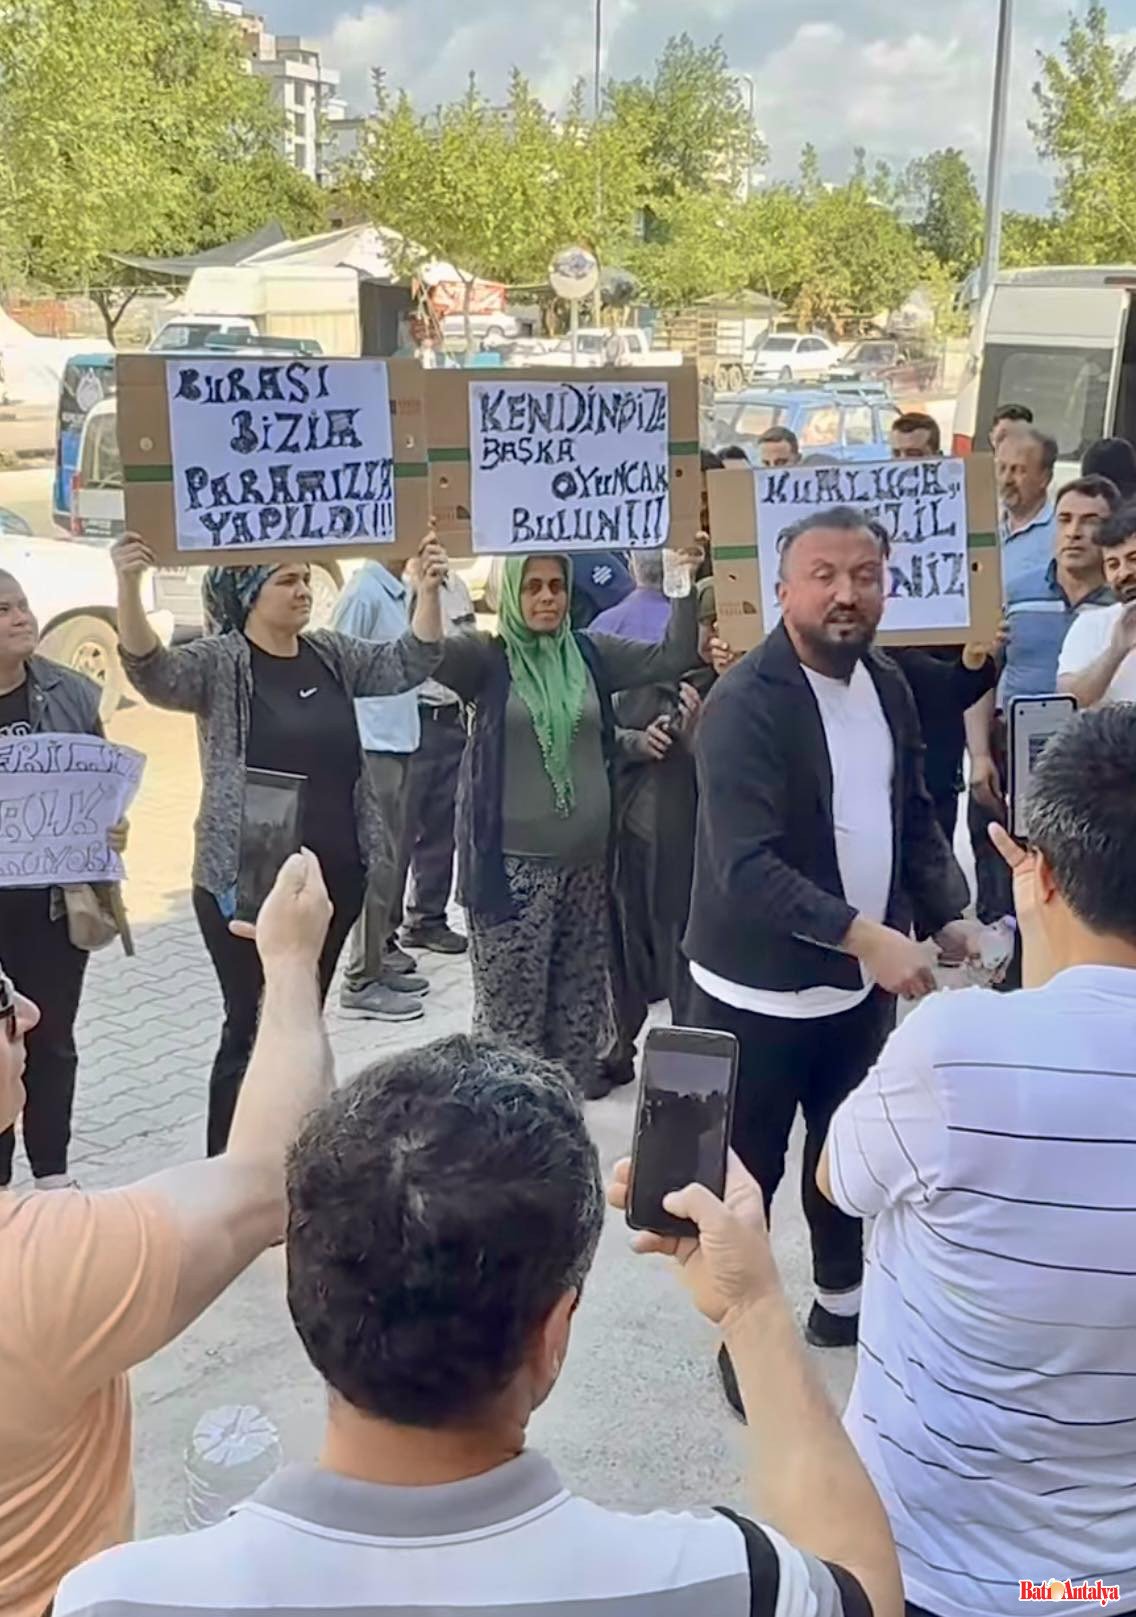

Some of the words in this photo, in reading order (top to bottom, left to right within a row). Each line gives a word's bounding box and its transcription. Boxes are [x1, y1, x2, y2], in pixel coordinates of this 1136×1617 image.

[174, 362, 329, 403] BURASI
[230, 408, 364, 454] BİZİM
[184, 458, 394, 510] PARAMIZLA
[551, 460, 669, 500] OYUNCAK
[199, 502, 393, 546] YAPILDI!!!
[511, 496, 666, 546] BULUN!!!
[863, 497, 956, 543] ZİL
[886, 552, 965, 598] NİZ
